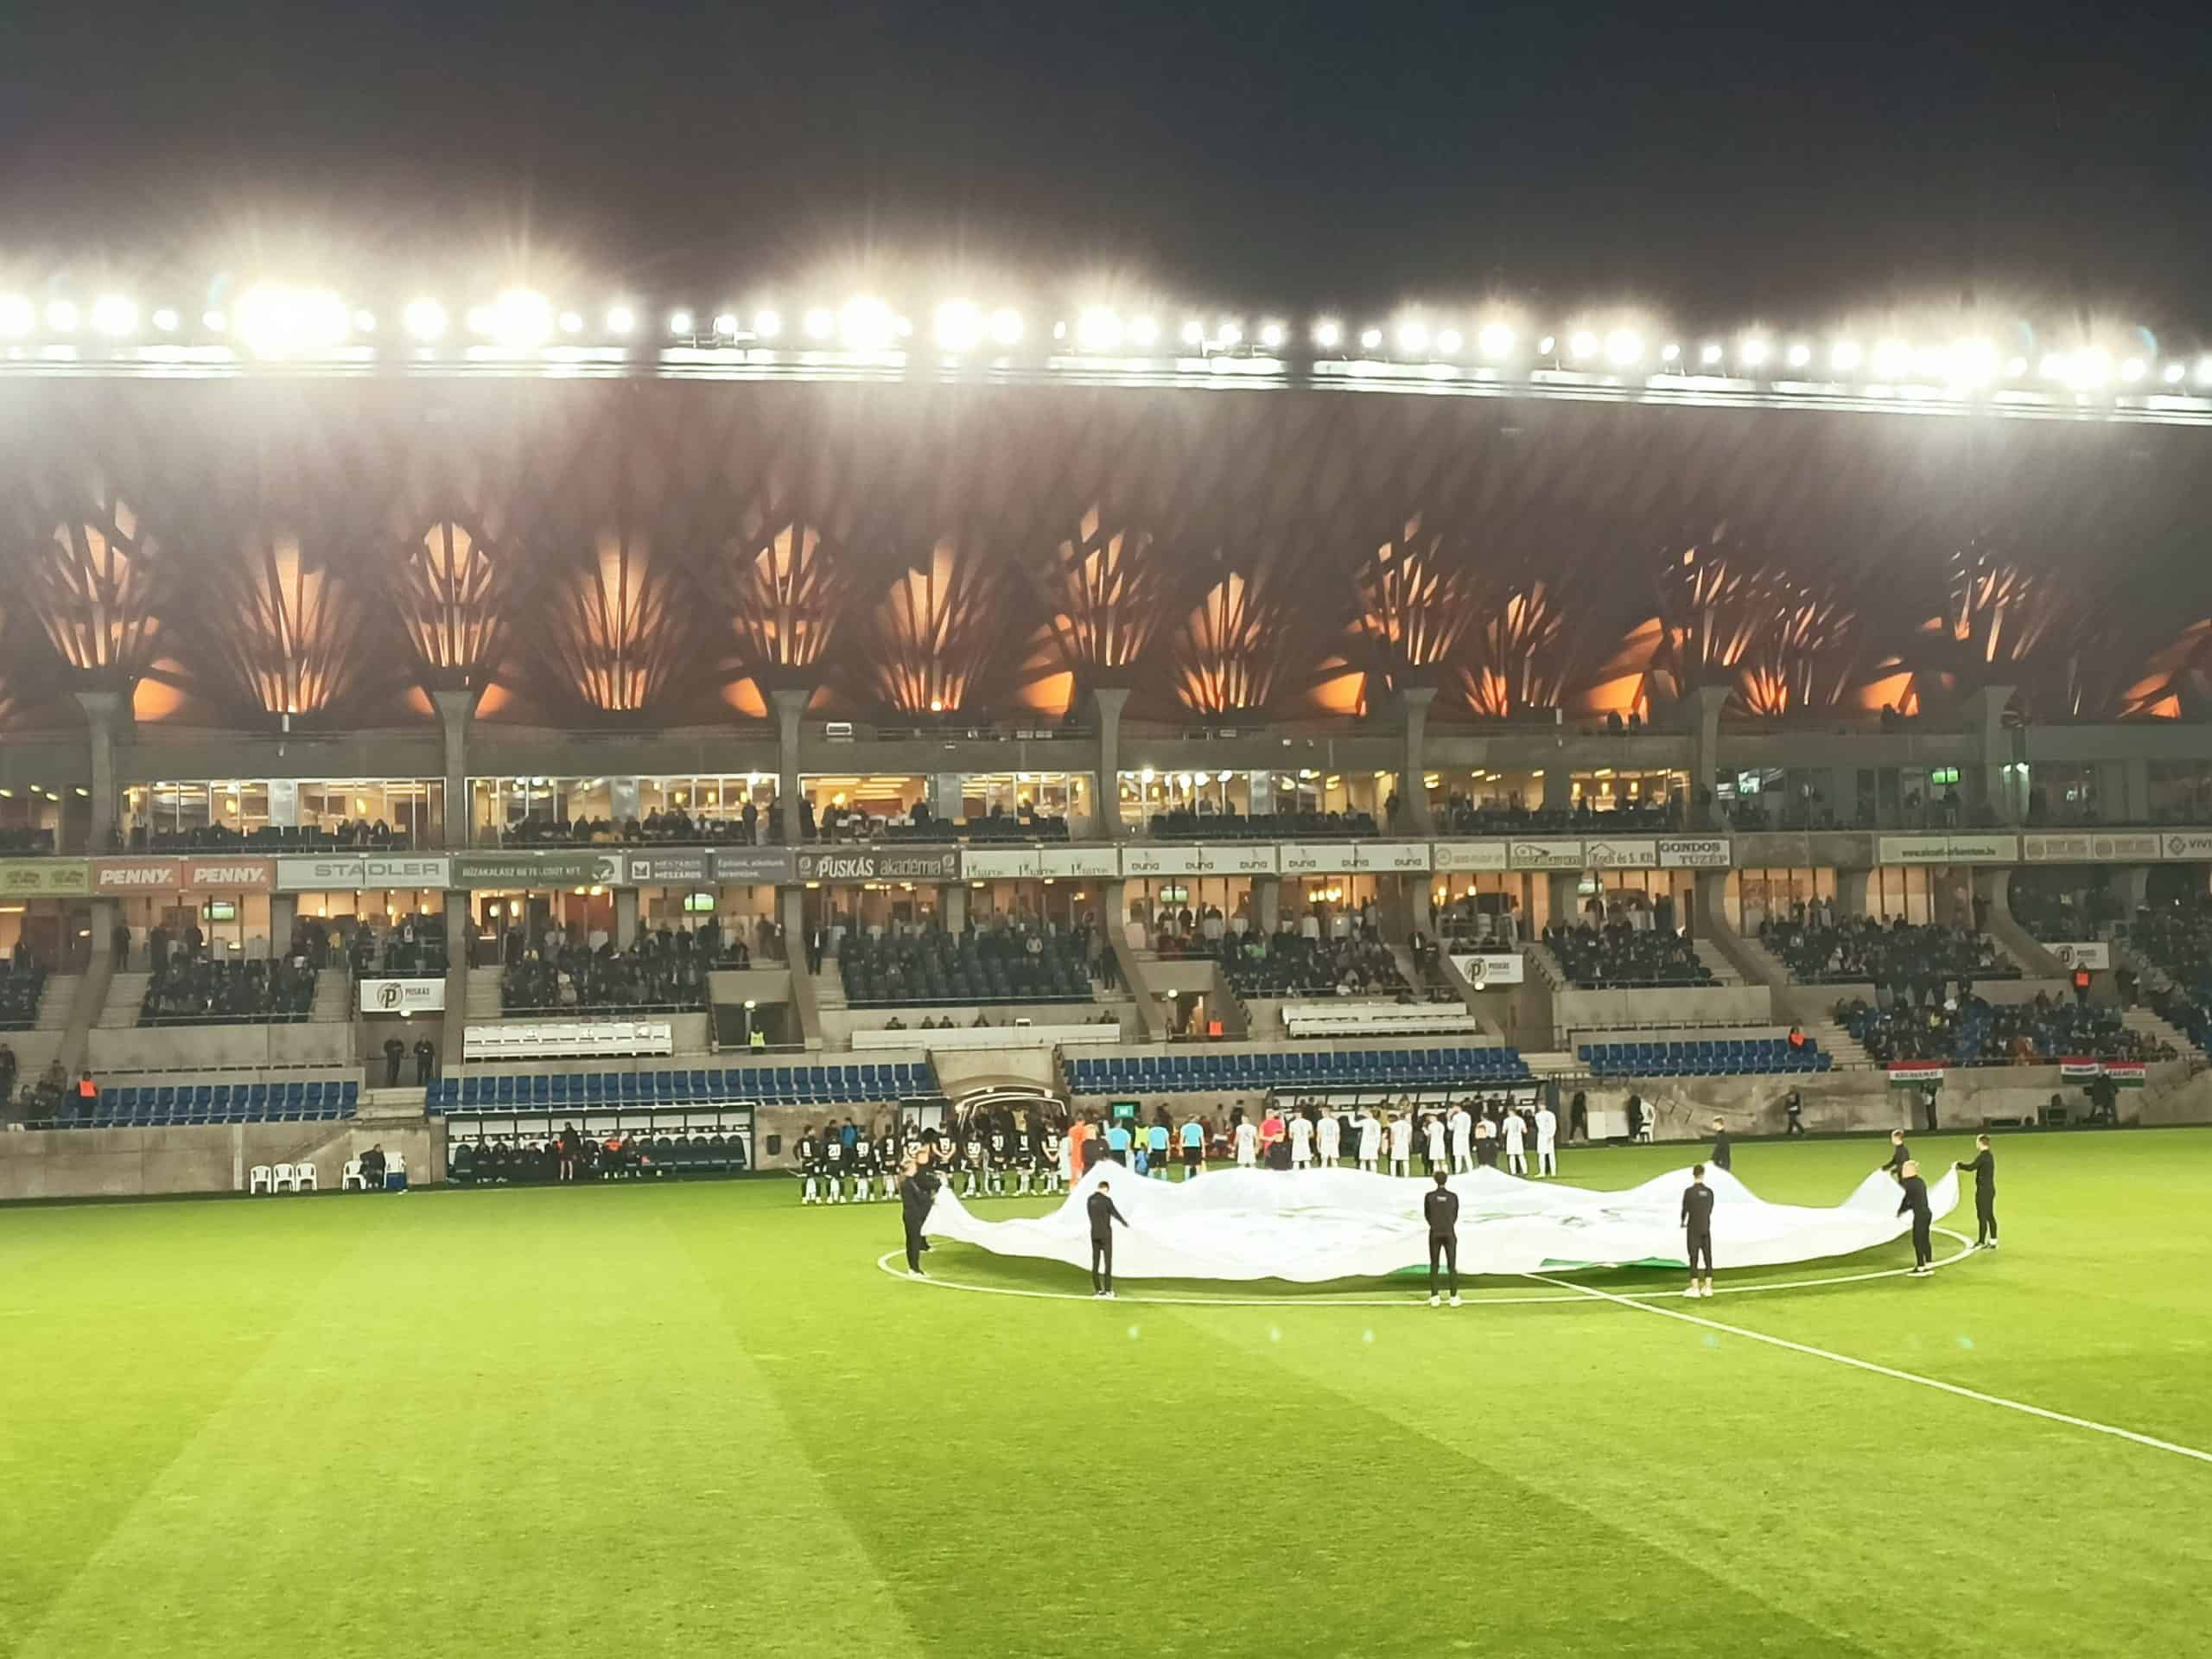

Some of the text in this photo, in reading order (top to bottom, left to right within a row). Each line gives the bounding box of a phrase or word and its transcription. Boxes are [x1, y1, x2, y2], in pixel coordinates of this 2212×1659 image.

[99, 868, 172, 885] PENNY.
[193, 867, 264, 883] PENNY.
[315, 863, 440, 876] STADLER
